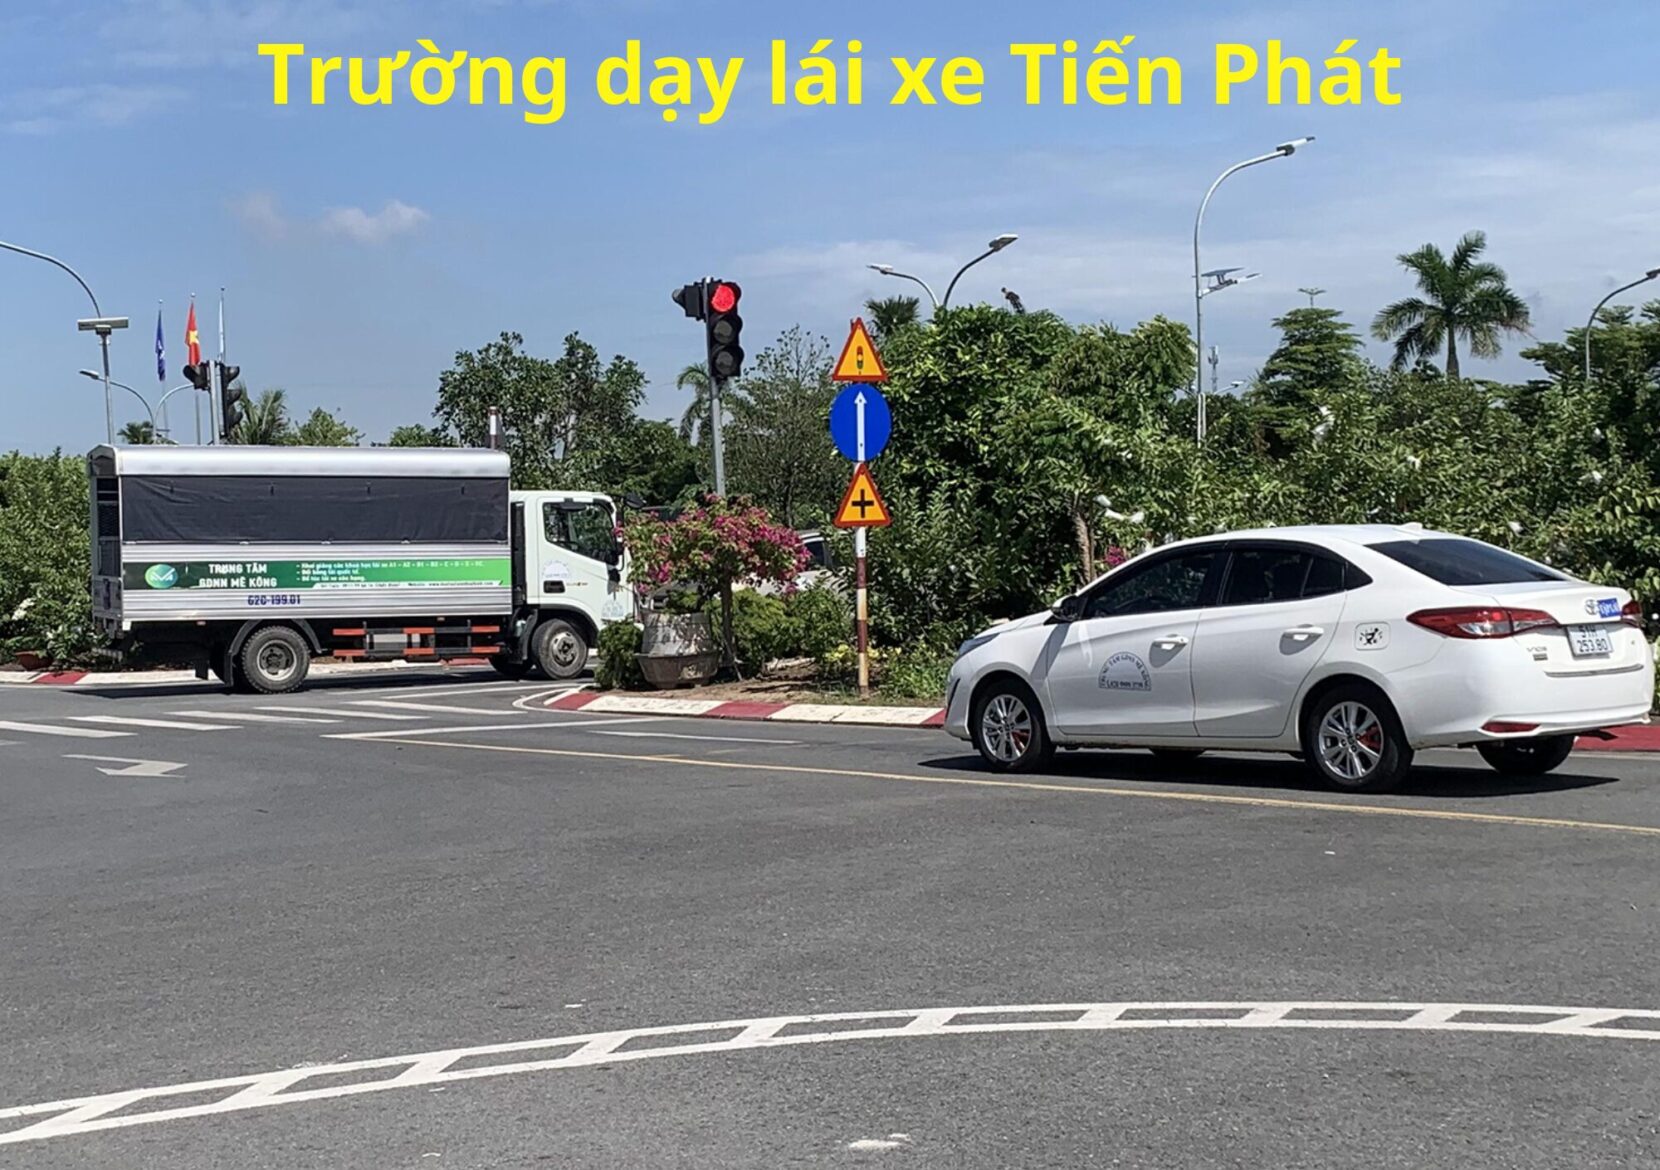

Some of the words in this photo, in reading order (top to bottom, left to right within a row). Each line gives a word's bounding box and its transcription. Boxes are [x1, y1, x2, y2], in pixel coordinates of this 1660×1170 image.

[208, 563, 243, 574] TRUNG
[245, 561, 267, 574] TÂM
[199, 577, 228, 588] GDNN
[230, 576, 246, 588] MÊ
[248, 576, 278, 588] KÔNG
